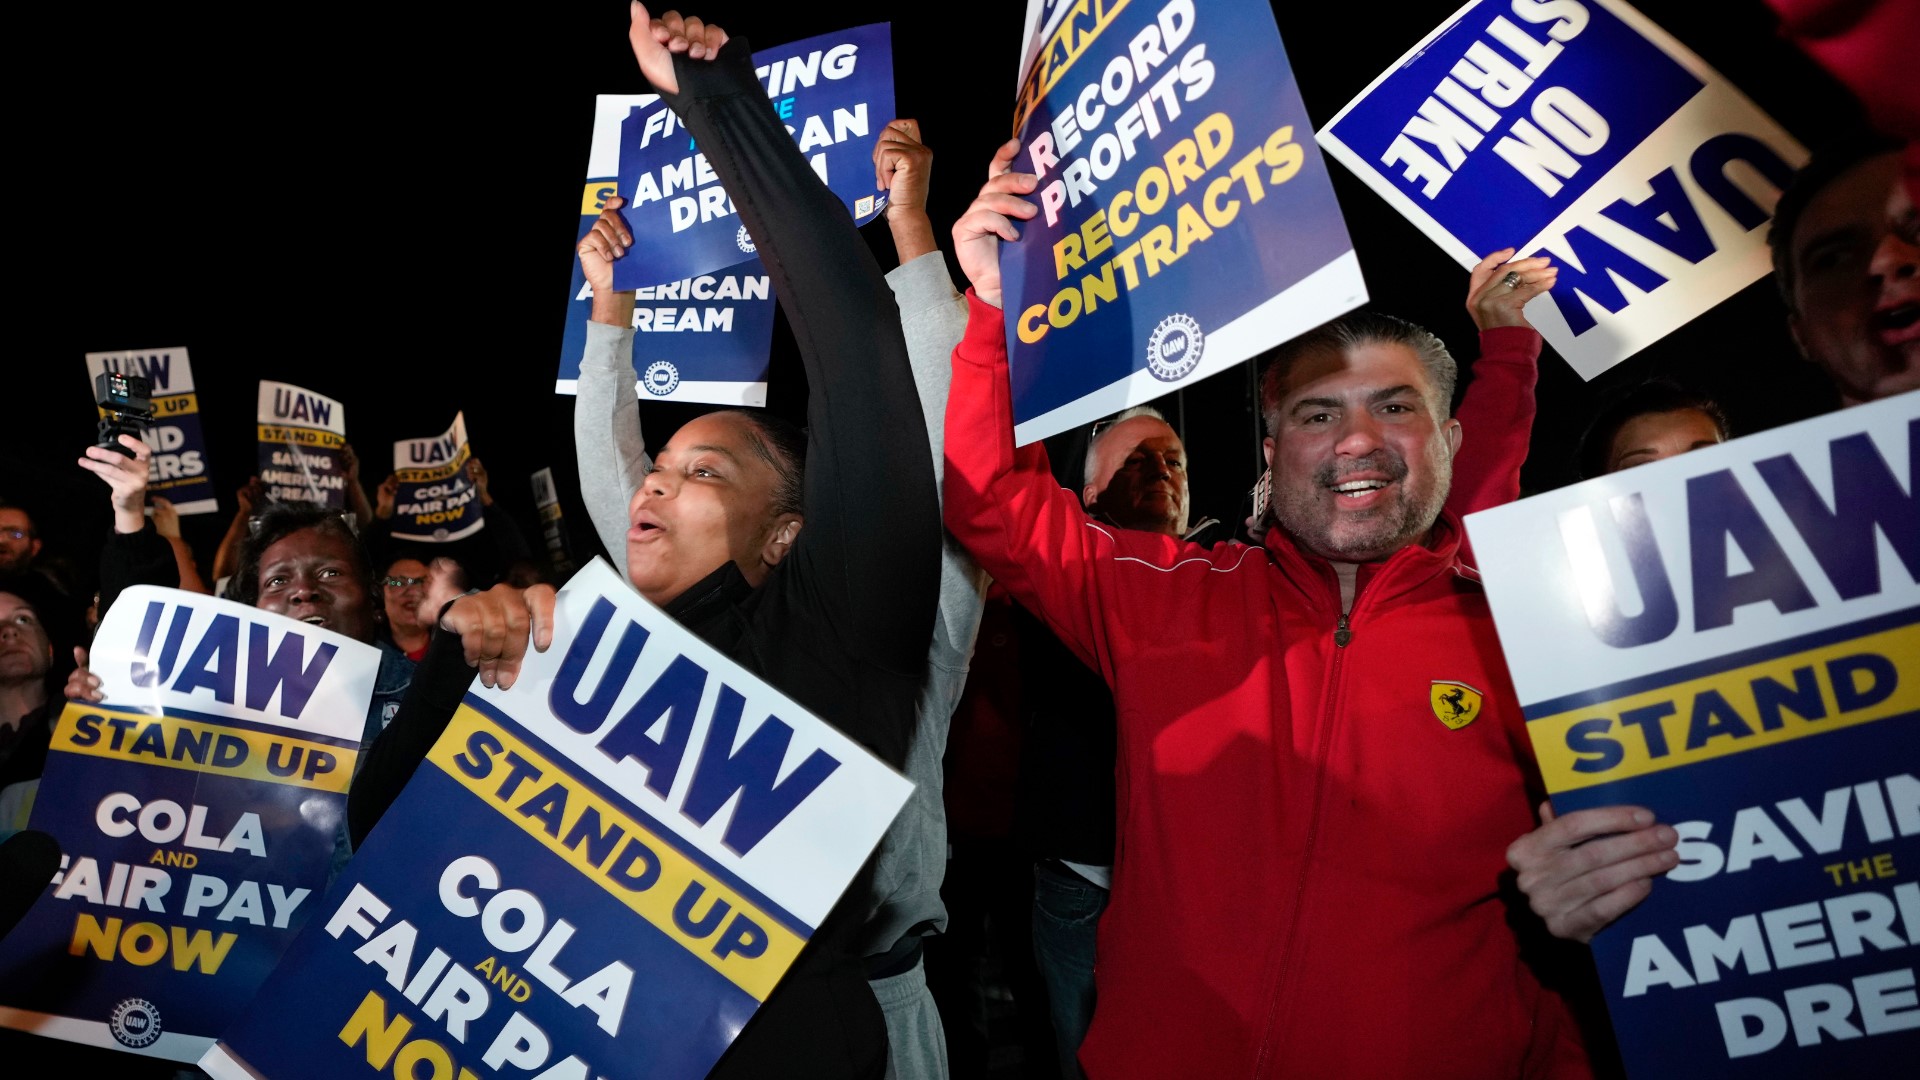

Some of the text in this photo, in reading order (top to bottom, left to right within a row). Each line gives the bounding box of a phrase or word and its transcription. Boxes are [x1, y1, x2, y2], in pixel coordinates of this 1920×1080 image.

[640, 43, 859, 149] FIING
[1013, 0, 1117, 129] STAN
[1028, 0, 1195, 179] RECORD
[1380, 0, 1590, 199] STRIKE
[632, 102, 869, 209] AMEAN
[1040, 43, 1215, 227] PROFITS
[1492, 86, 1610, 198] ON
[1053, 112, 1234, 280] RECORD
[1017, 125, 1304, 344] CONTRACTS
[1529, 133, 1797, 337] UAW
[575, 276, 770, 300] ERICAN
[632, 307, 734, 332] REAM
[1162, 335, 1185, 357] UAW
[139, 425, 184, 453] ND
[164, 401, 189, 413] UP
[263, 428, 318, 443] STAND
[274, 387, 331, 426] UAW
[410, 425, 458, 463] UAW
[397, 483, 476, 515] FAIR PAY
[414, 478, 465, 500] COLA
[416, 506, 465, 525] NOW
[1557, 418, 1920, 649] UAW
[130, 600, 339, 719] UAW
[548, 594, 842, 858] UAW
[1565, 652, 1899, 773] STAND
[69, 714, 337, 781] STAND UP
[95, 792, 267, 857] COLA
[453, 729, 769, 962] STAND UP
[150, 848, 198, 869] AND
[1824, 853, 1897, 887] THE
[182, 874, 312, 929] PAY
[68, 912, 238, 976] NOW
[324, 882, 491, 1044] FAIR
[438, 855, 635, 1038] COLA
[474, 955, 532, 1003] AND
[126, 1015, 147, 1028] UAW
[338, 990, 480, 1080] NO
